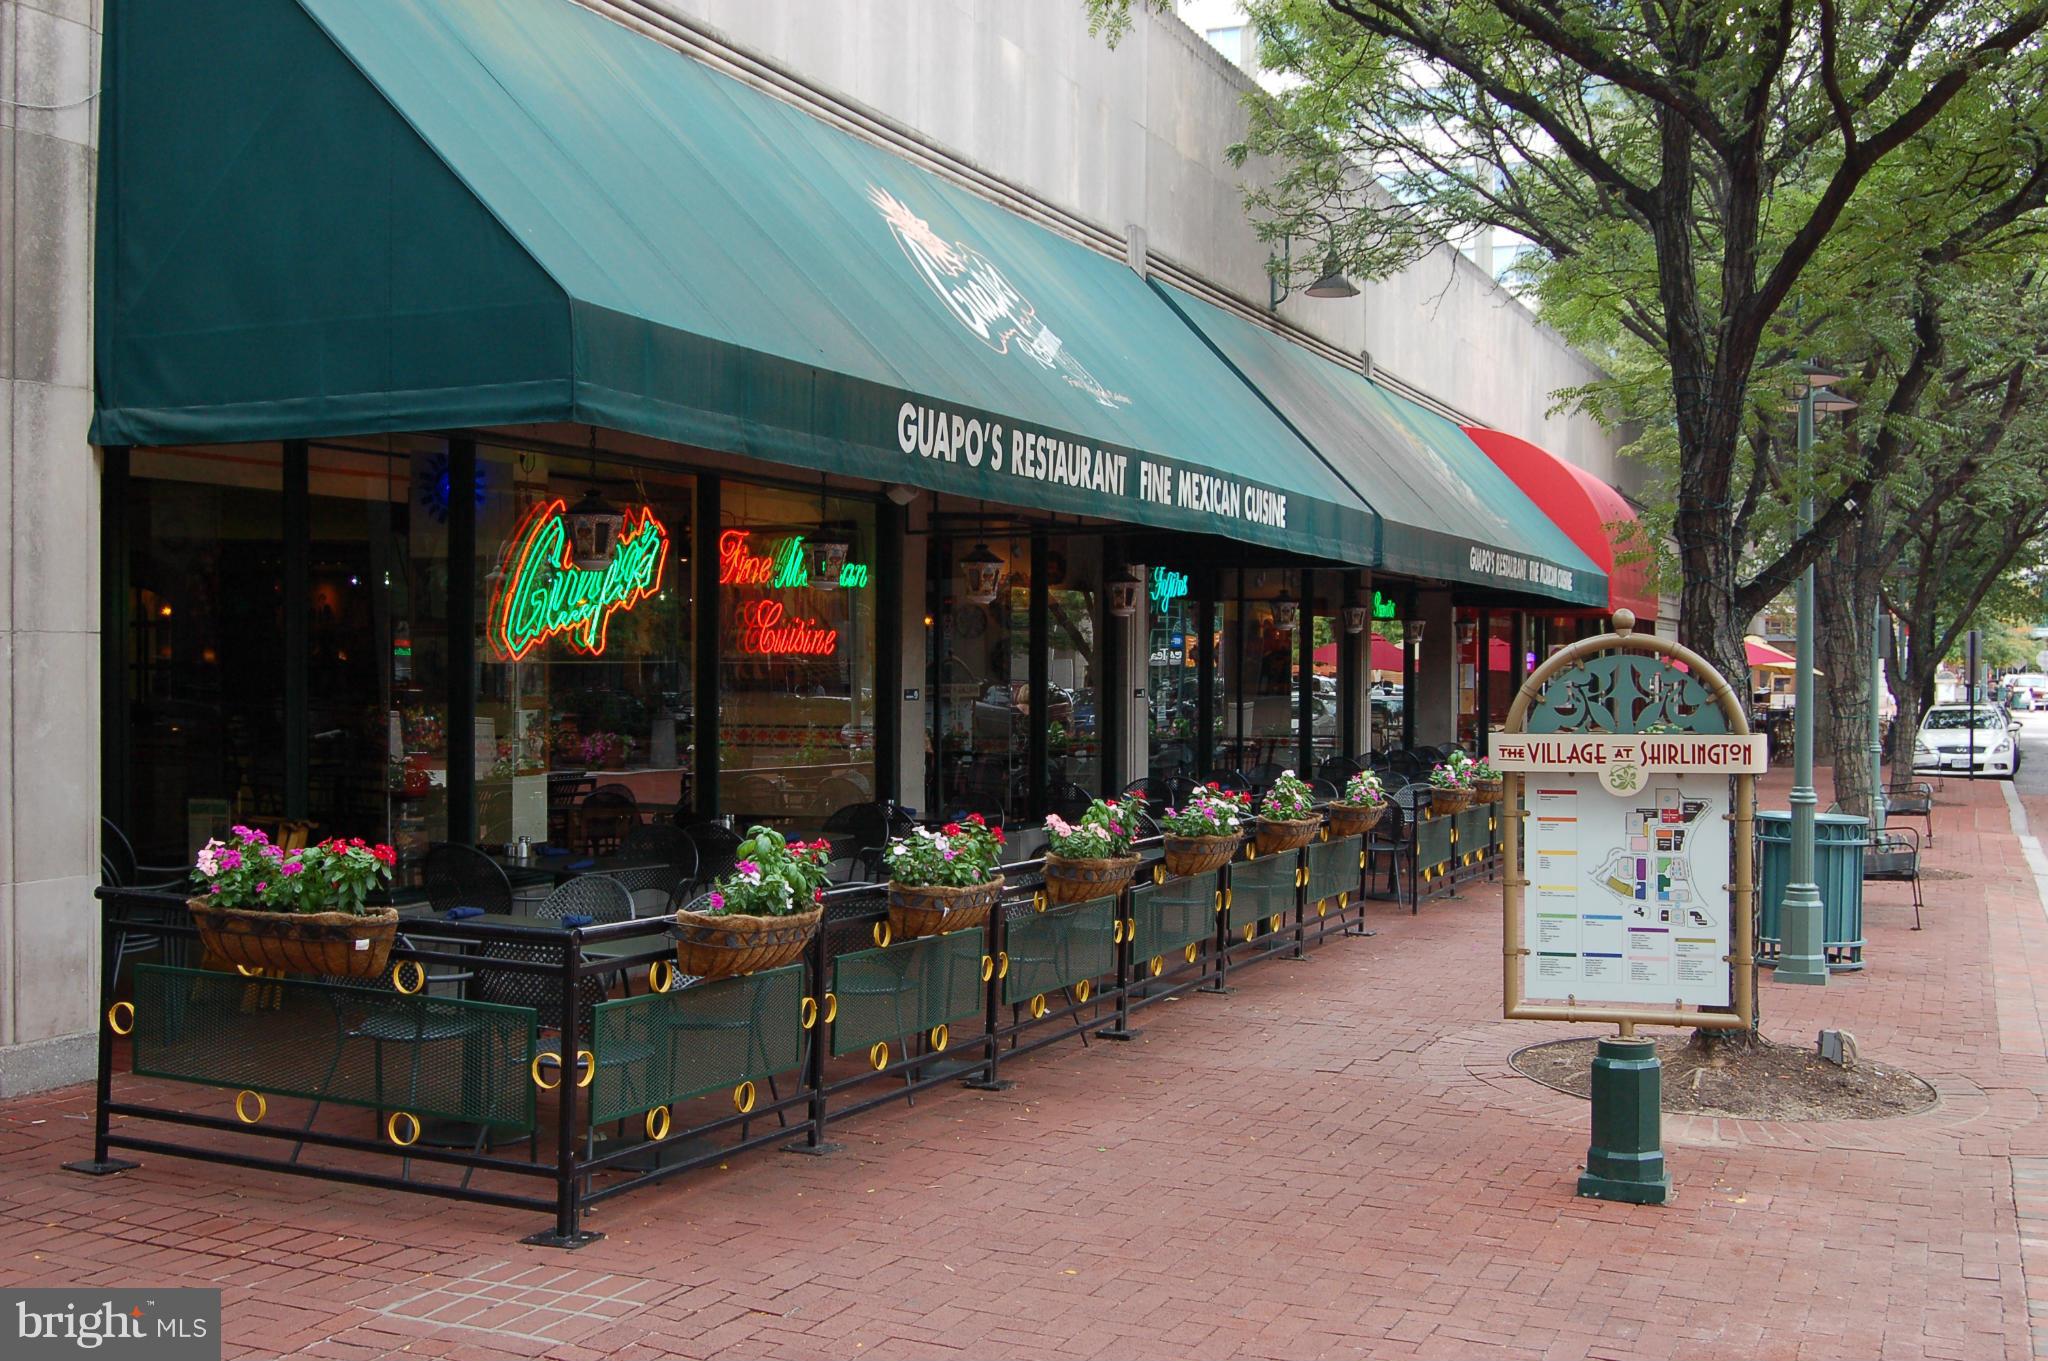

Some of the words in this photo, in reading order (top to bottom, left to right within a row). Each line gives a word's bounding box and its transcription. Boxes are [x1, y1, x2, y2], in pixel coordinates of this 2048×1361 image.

[897, 402, 1003, 471] GUAPO'S
[1011, 429, 1128, 496] RESTAURANT
[1139, 460, 1172, 505] FINE
[1177, 469, 1241, 518] MEXICAN
[1244, 485, 1287, 529] CUISINE
[720, 529, 773, 584] Fine
[1469, 546, 1495, 574] GUAPO'S
[757, 599, 837, 655] Cuisine
[1499, 748, 1525, 759] THE
[1527, 742, 1606, 764] VILLAGE
[1614, 748, 1633, 759] AT
[1641, 741, 1752, 767] SHIRLINGTON
